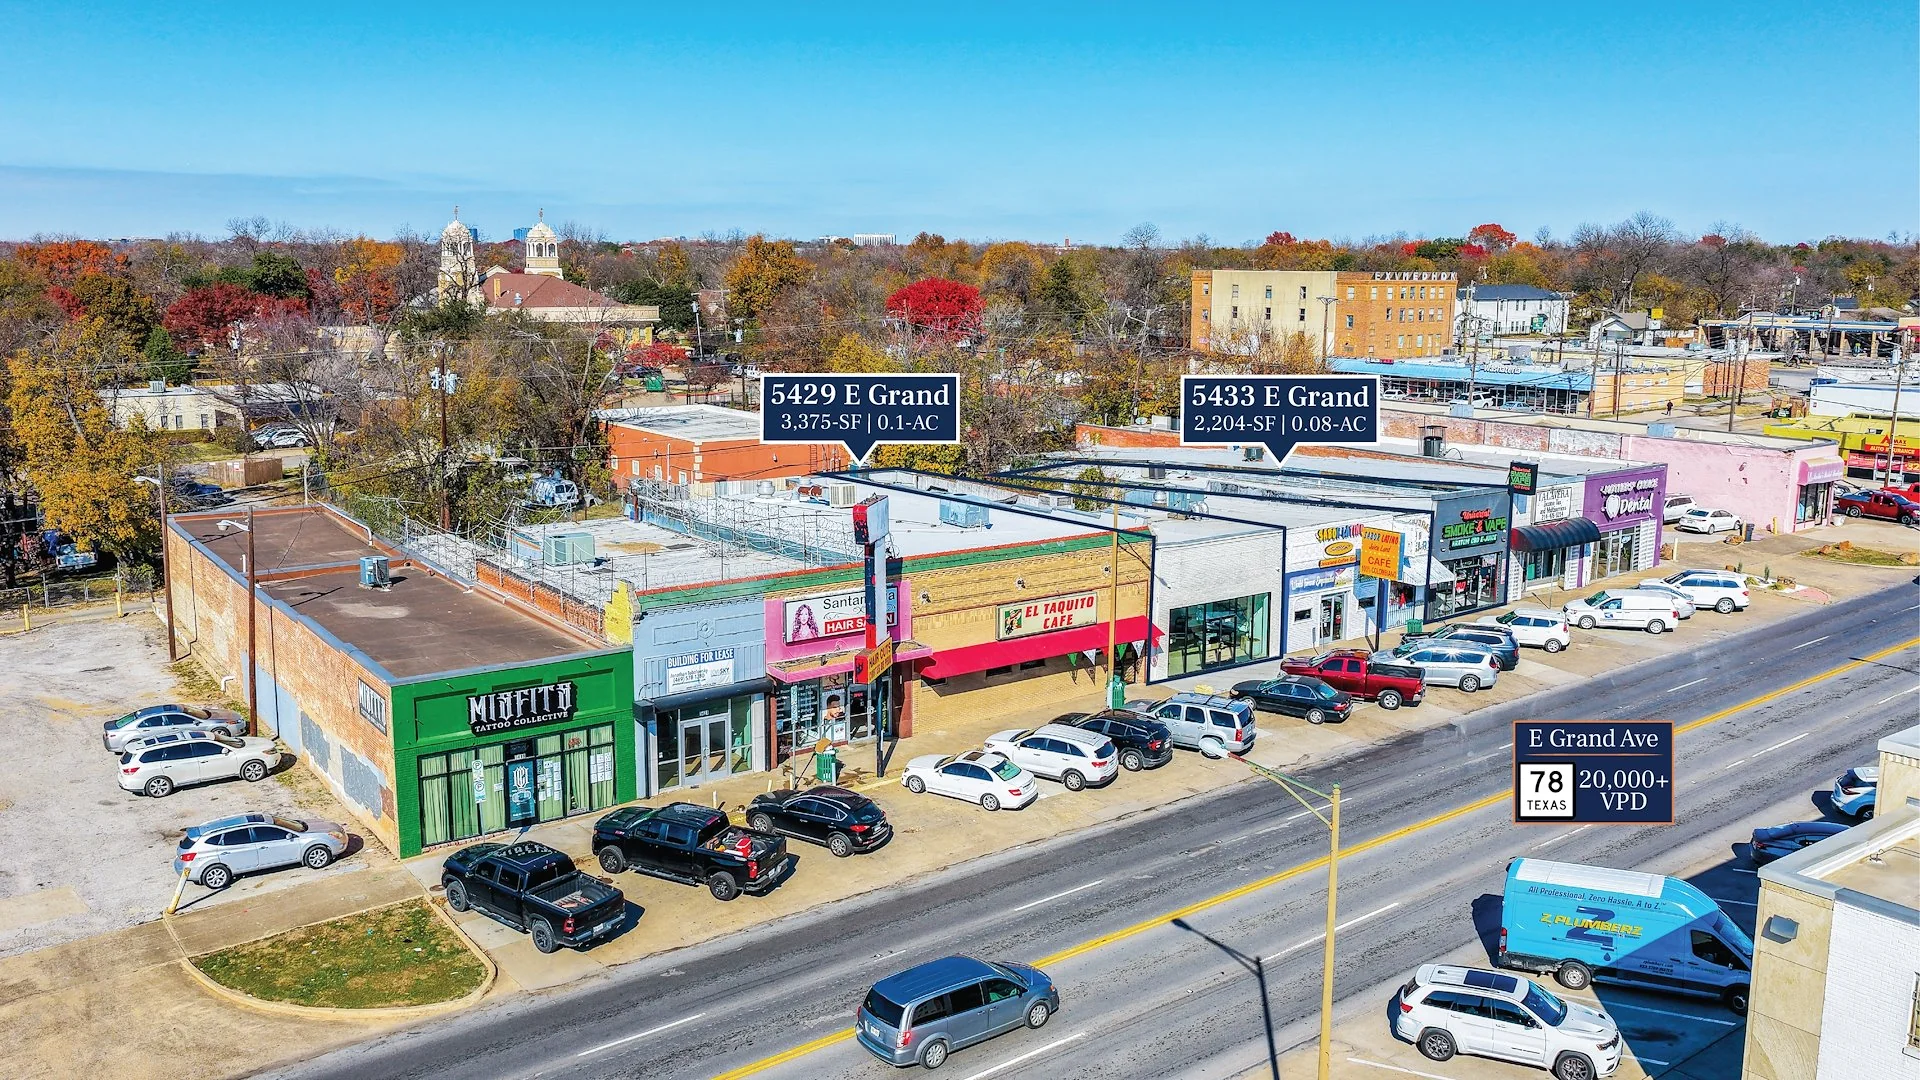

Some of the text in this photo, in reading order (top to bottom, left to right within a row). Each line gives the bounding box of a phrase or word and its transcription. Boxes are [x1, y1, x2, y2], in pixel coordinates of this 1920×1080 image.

[1620, 493, 1654, 514] Dental
[1363, 531, 1399, 545] SABOR LATINO
[1443, 521, 1475, 538] SMOKE
[1475, 520, 1483, 533] &
[1484, 517, 1506, 531] VAPE
[1367, 556, 1392, 569] CAFÉ
[1025, 596, 1095, 618] EL TAQUITO
[826, 620, 854, 633] HAIR
[1043, 614, 1073, 629] CAFE
[668, 648, 734, 668] BUILDING FOR LEASE
[868, 651, 879, 668] HAIR
[468, 682, 573, 724] MISFITS
[474, 711, 569, 733] TATTOO COLLECTIVE
[1528, 886, 1538, 894] All
[1540, 887, 1586, 900] Professional.
[1588, 894, 1606, 902] Zero
[1607, 896, 1633, 907] Hassle.
[1541, 913, 1643, 936] Z PLUMBERZ
